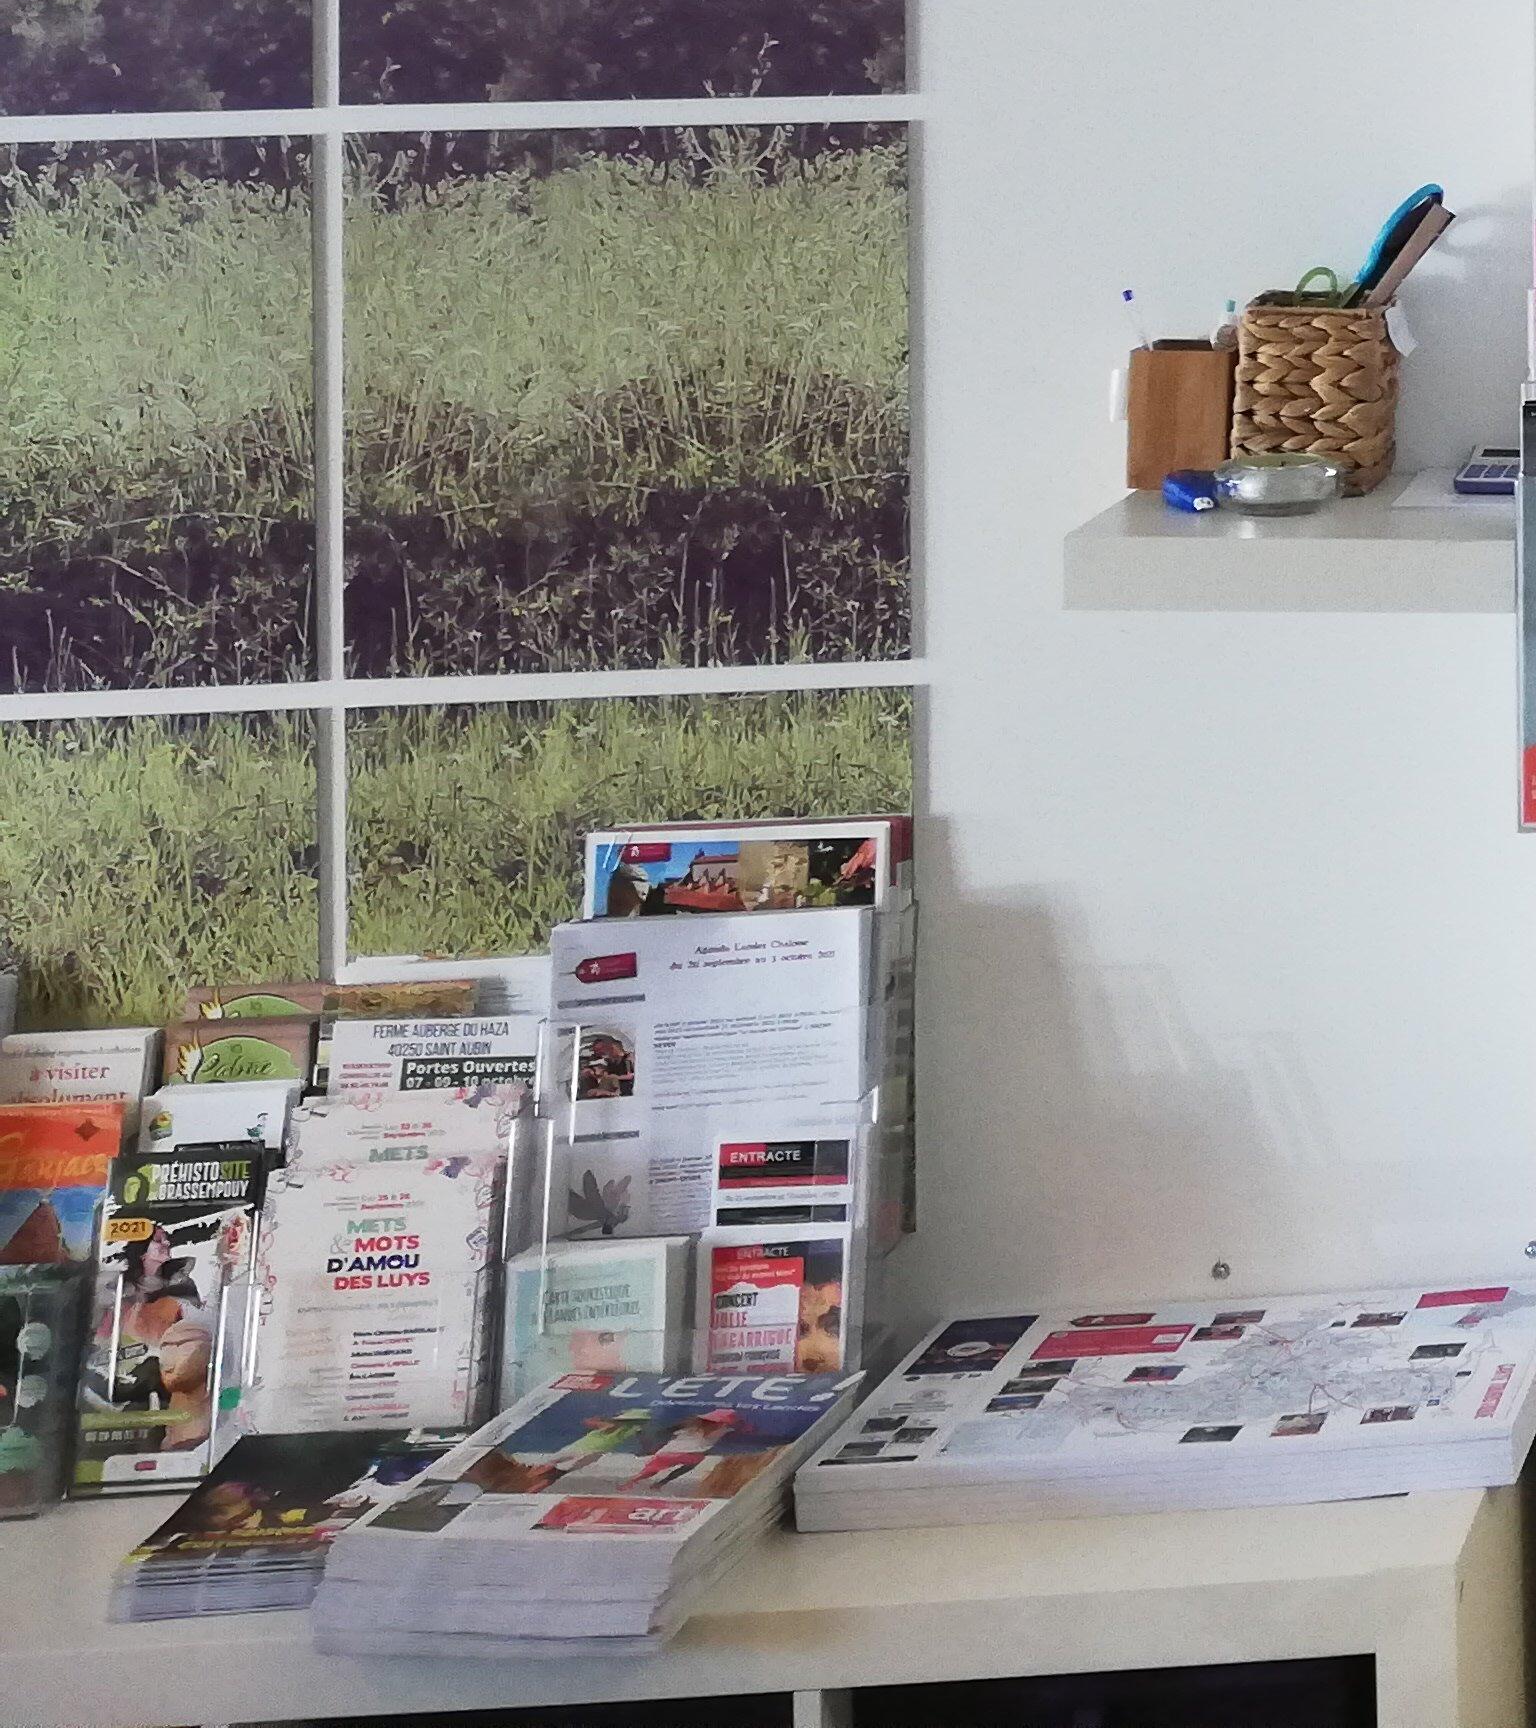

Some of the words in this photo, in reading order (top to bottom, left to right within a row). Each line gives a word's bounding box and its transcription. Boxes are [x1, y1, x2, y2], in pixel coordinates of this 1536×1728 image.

[373, 1023, 408, 1038] FERME
[411, 1022, 461, 1038] AUBERGE
[463, 1022, 478, 1037] DU
[480, 1021, 510, 1037] HAZA
[424, 1041, 458, 1056] SAINT
[459, 1040, 494, 1056] AUBIN
[46, 1062, 111, 1081] visiter
[406, 1061, 460, 1076] Portes
[462, 1059, 536, 1073] Ouvertes
[405, 1077, 424, 1088] 07
[368, 1145, 429, 1163] METS
[730, 1149, 801, 1163] ENTRACTE
[158, 1179, 250, 1201] BRASSEMPOUY
[109, 1221, 147, 1236] 2021
[346, 1216, 407, 1234] METS
[354, 1234, 420, 1253] MOTS
[326, 1253, 420, 1274] D'AMOU
[333, 1274, 373, 1290] DES
[376, 1271, 431, 1288] LUYS
